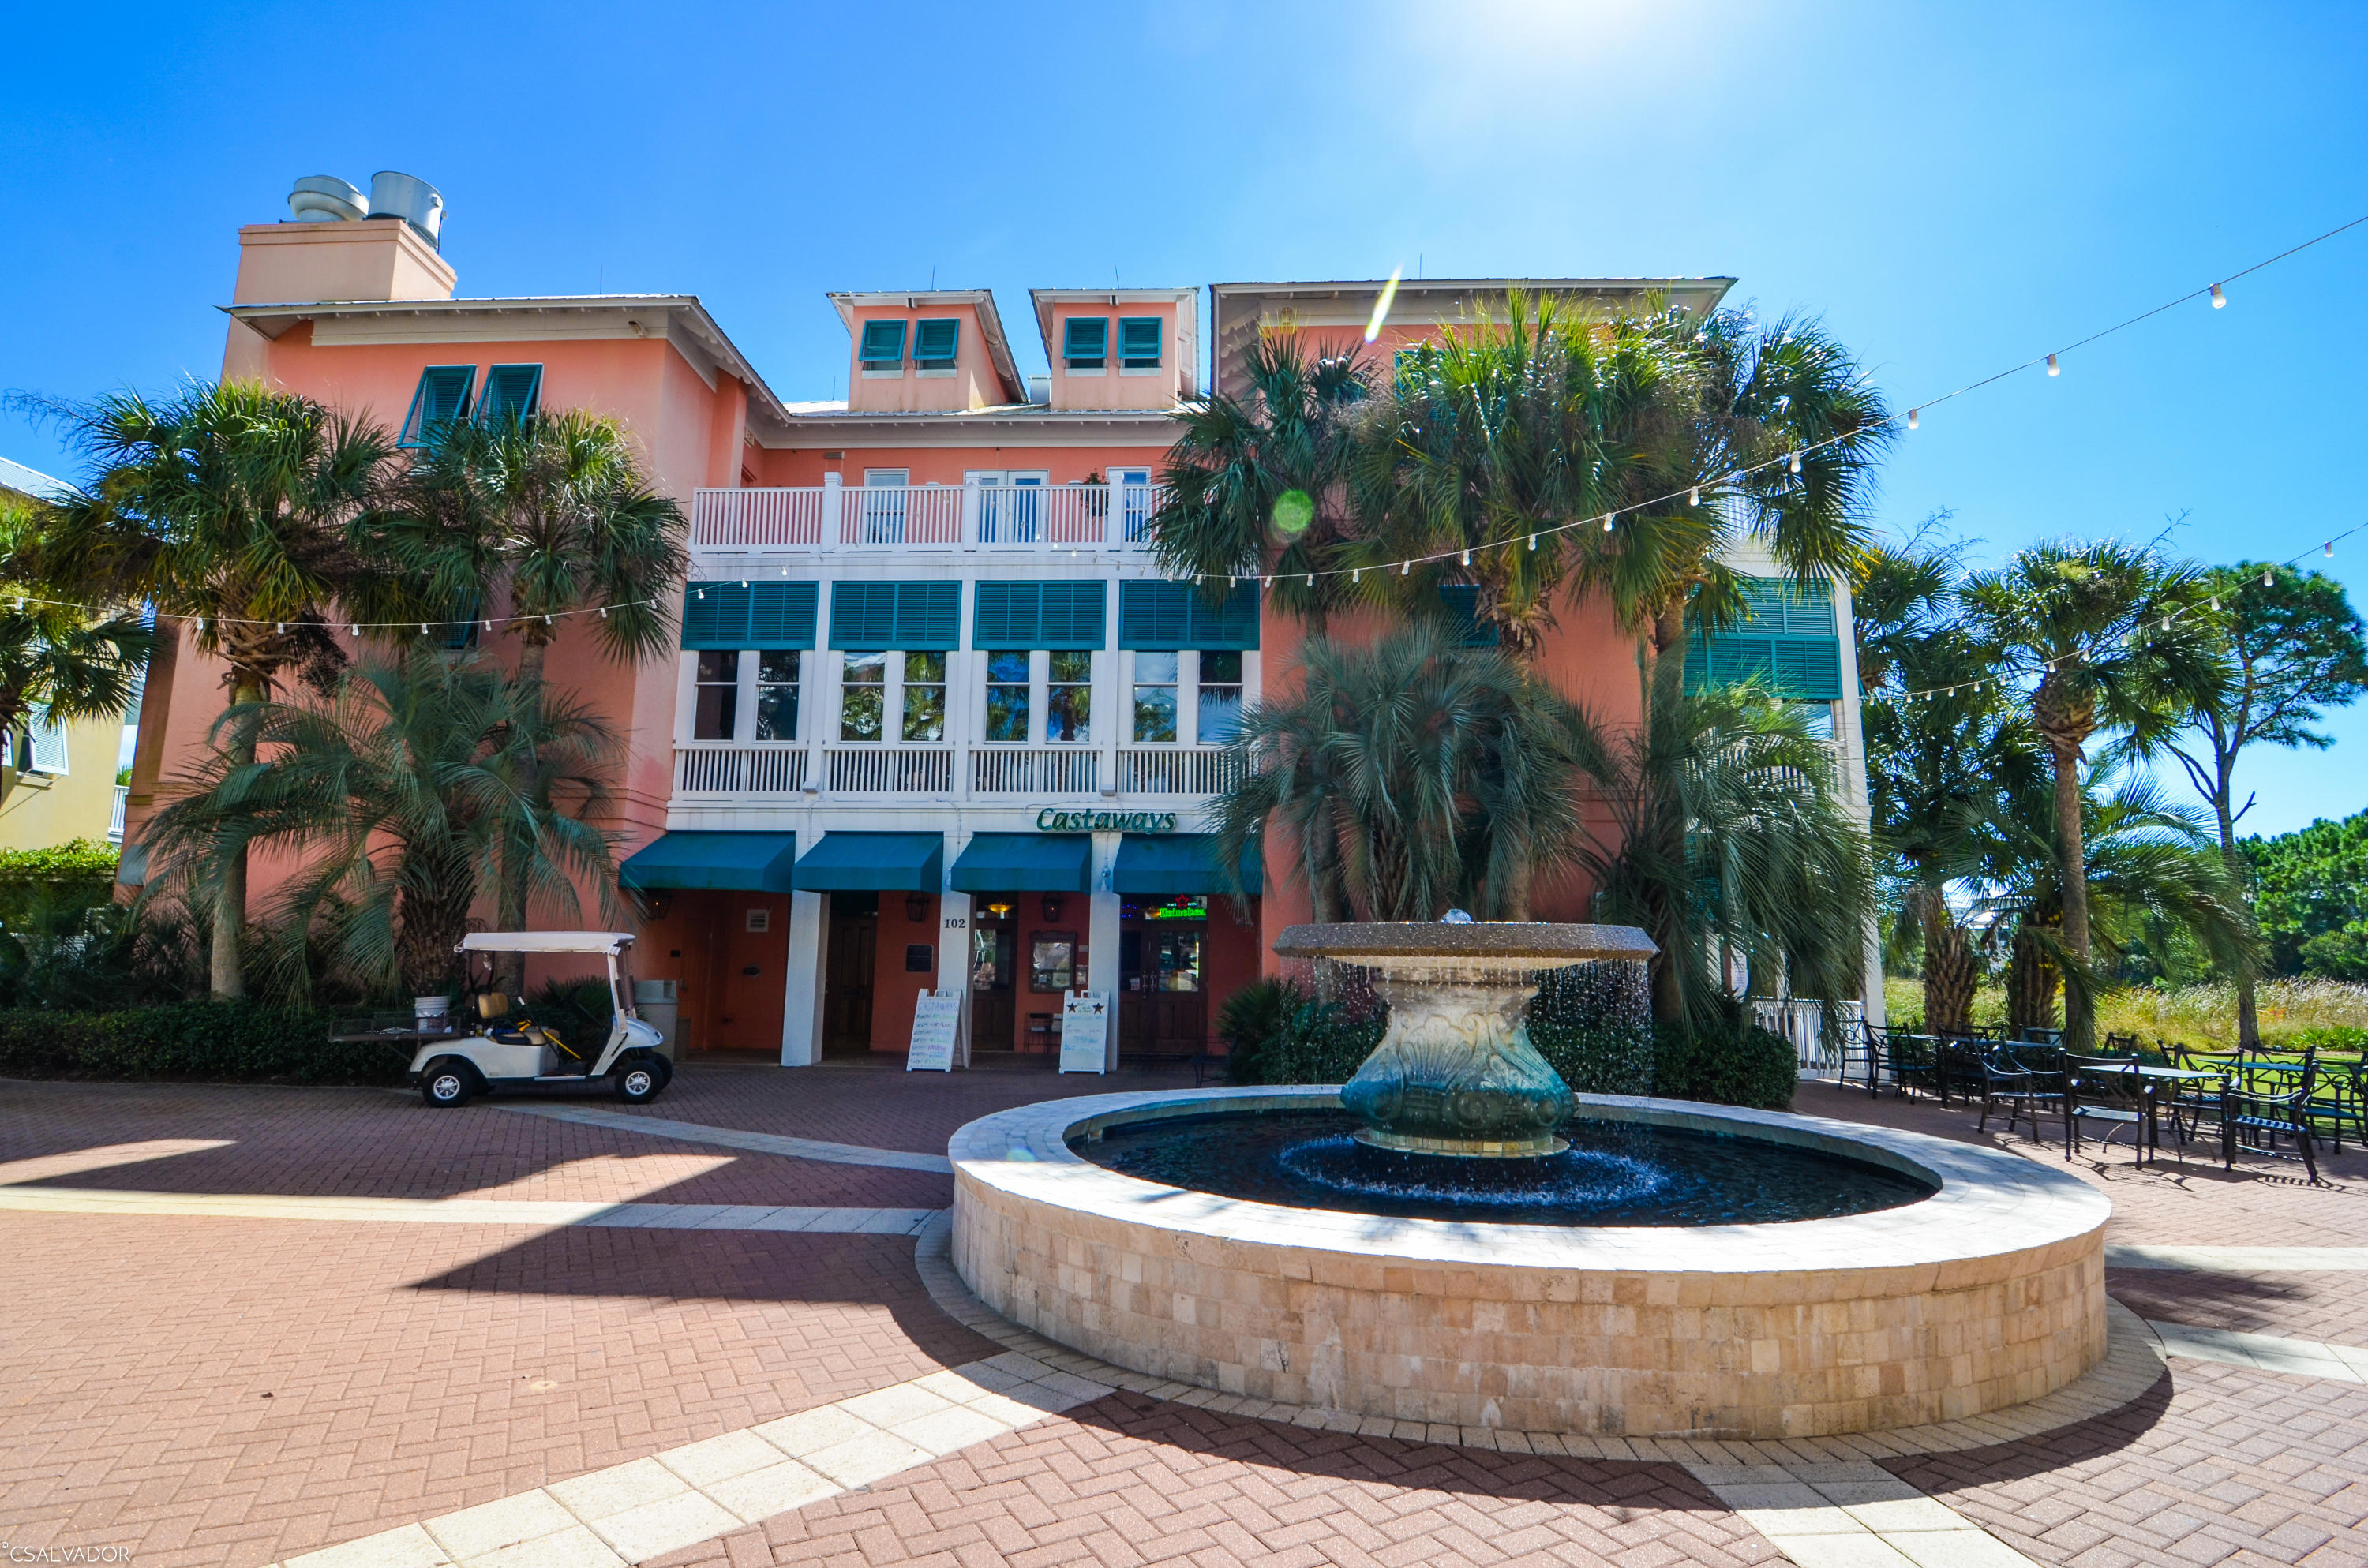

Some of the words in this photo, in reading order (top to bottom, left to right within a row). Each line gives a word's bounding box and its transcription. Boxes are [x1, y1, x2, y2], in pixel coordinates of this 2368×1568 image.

[1036, 807, 1176, 835] Castaways
[1160, 907, 1206, 917] Heineken
[945, 919, 965, 929] 102
